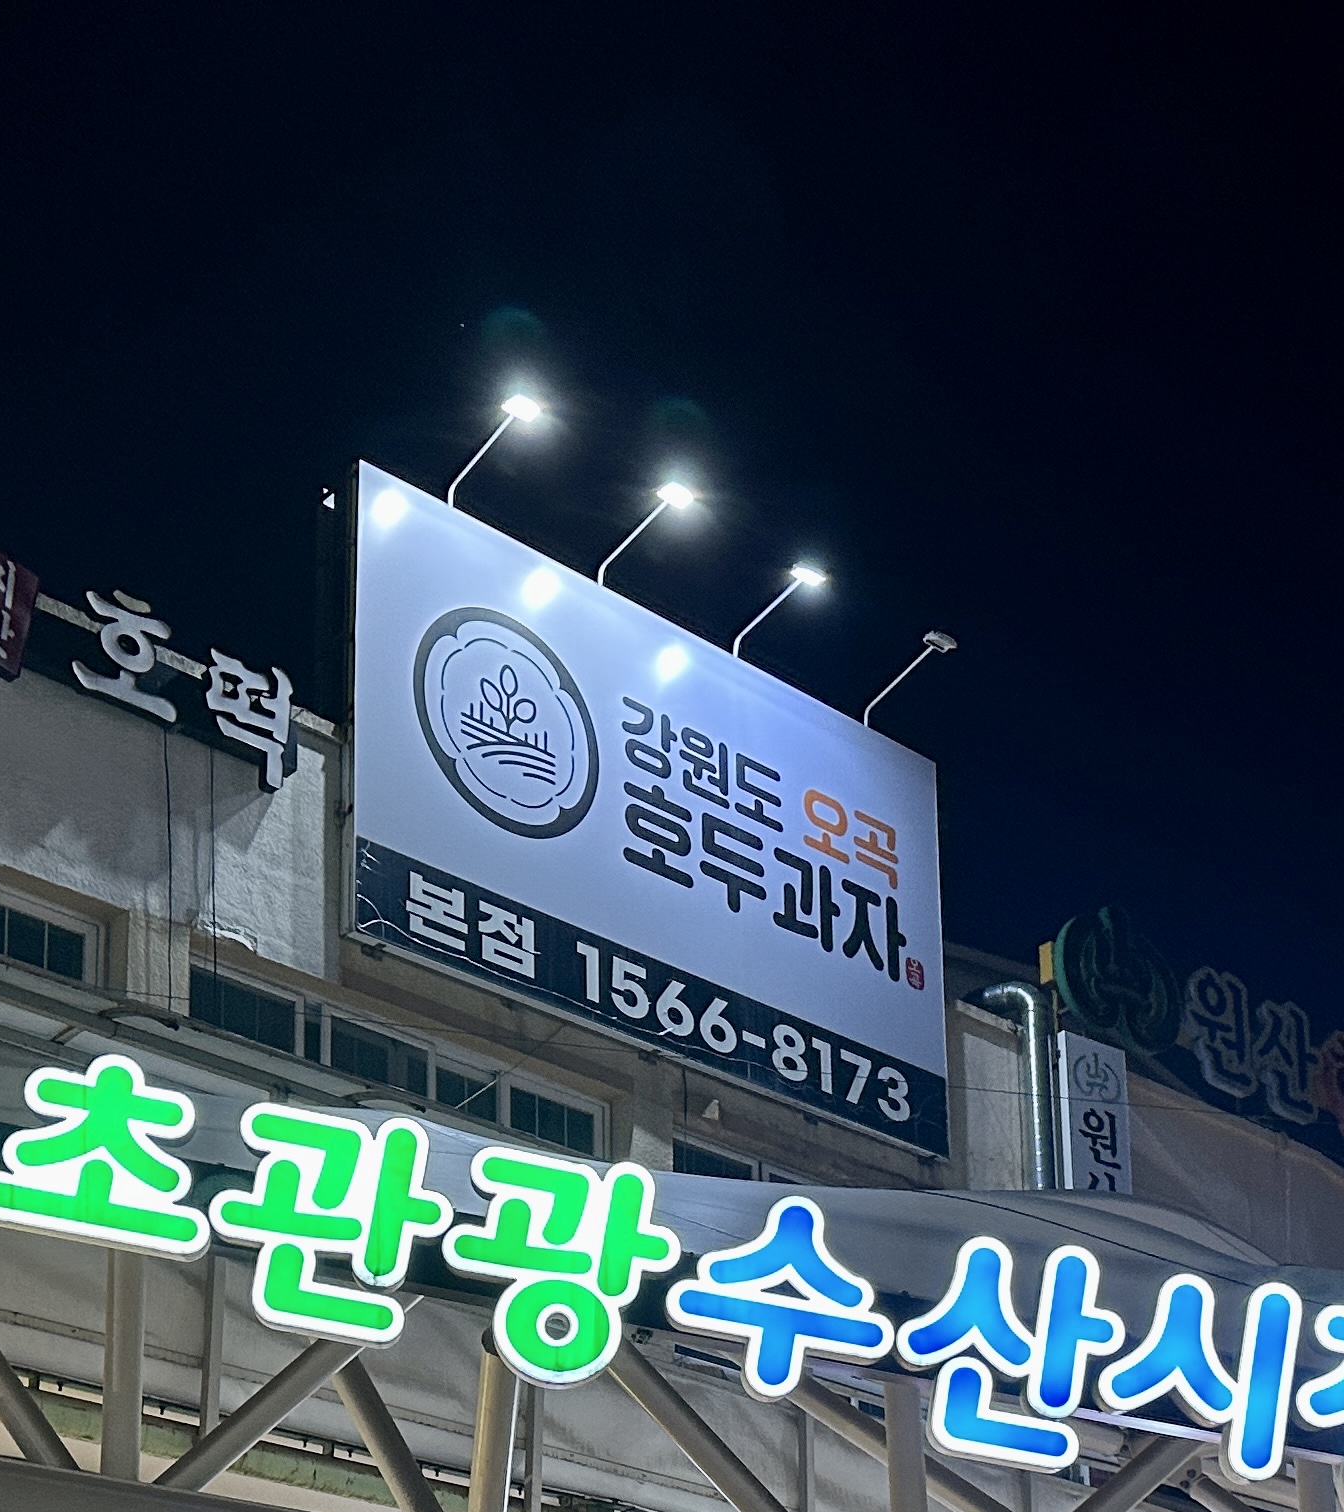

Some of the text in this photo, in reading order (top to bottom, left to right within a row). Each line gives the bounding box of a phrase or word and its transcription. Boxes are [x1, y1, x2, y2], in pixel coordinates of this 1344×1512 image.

[72, 589, 298, 792] 호떡
[622, 697, 901, 890] 강원도 오곡
[623, 780, 908, 983] 호두과자
[404, 871, 910, 1123] 본점 1566-8173
